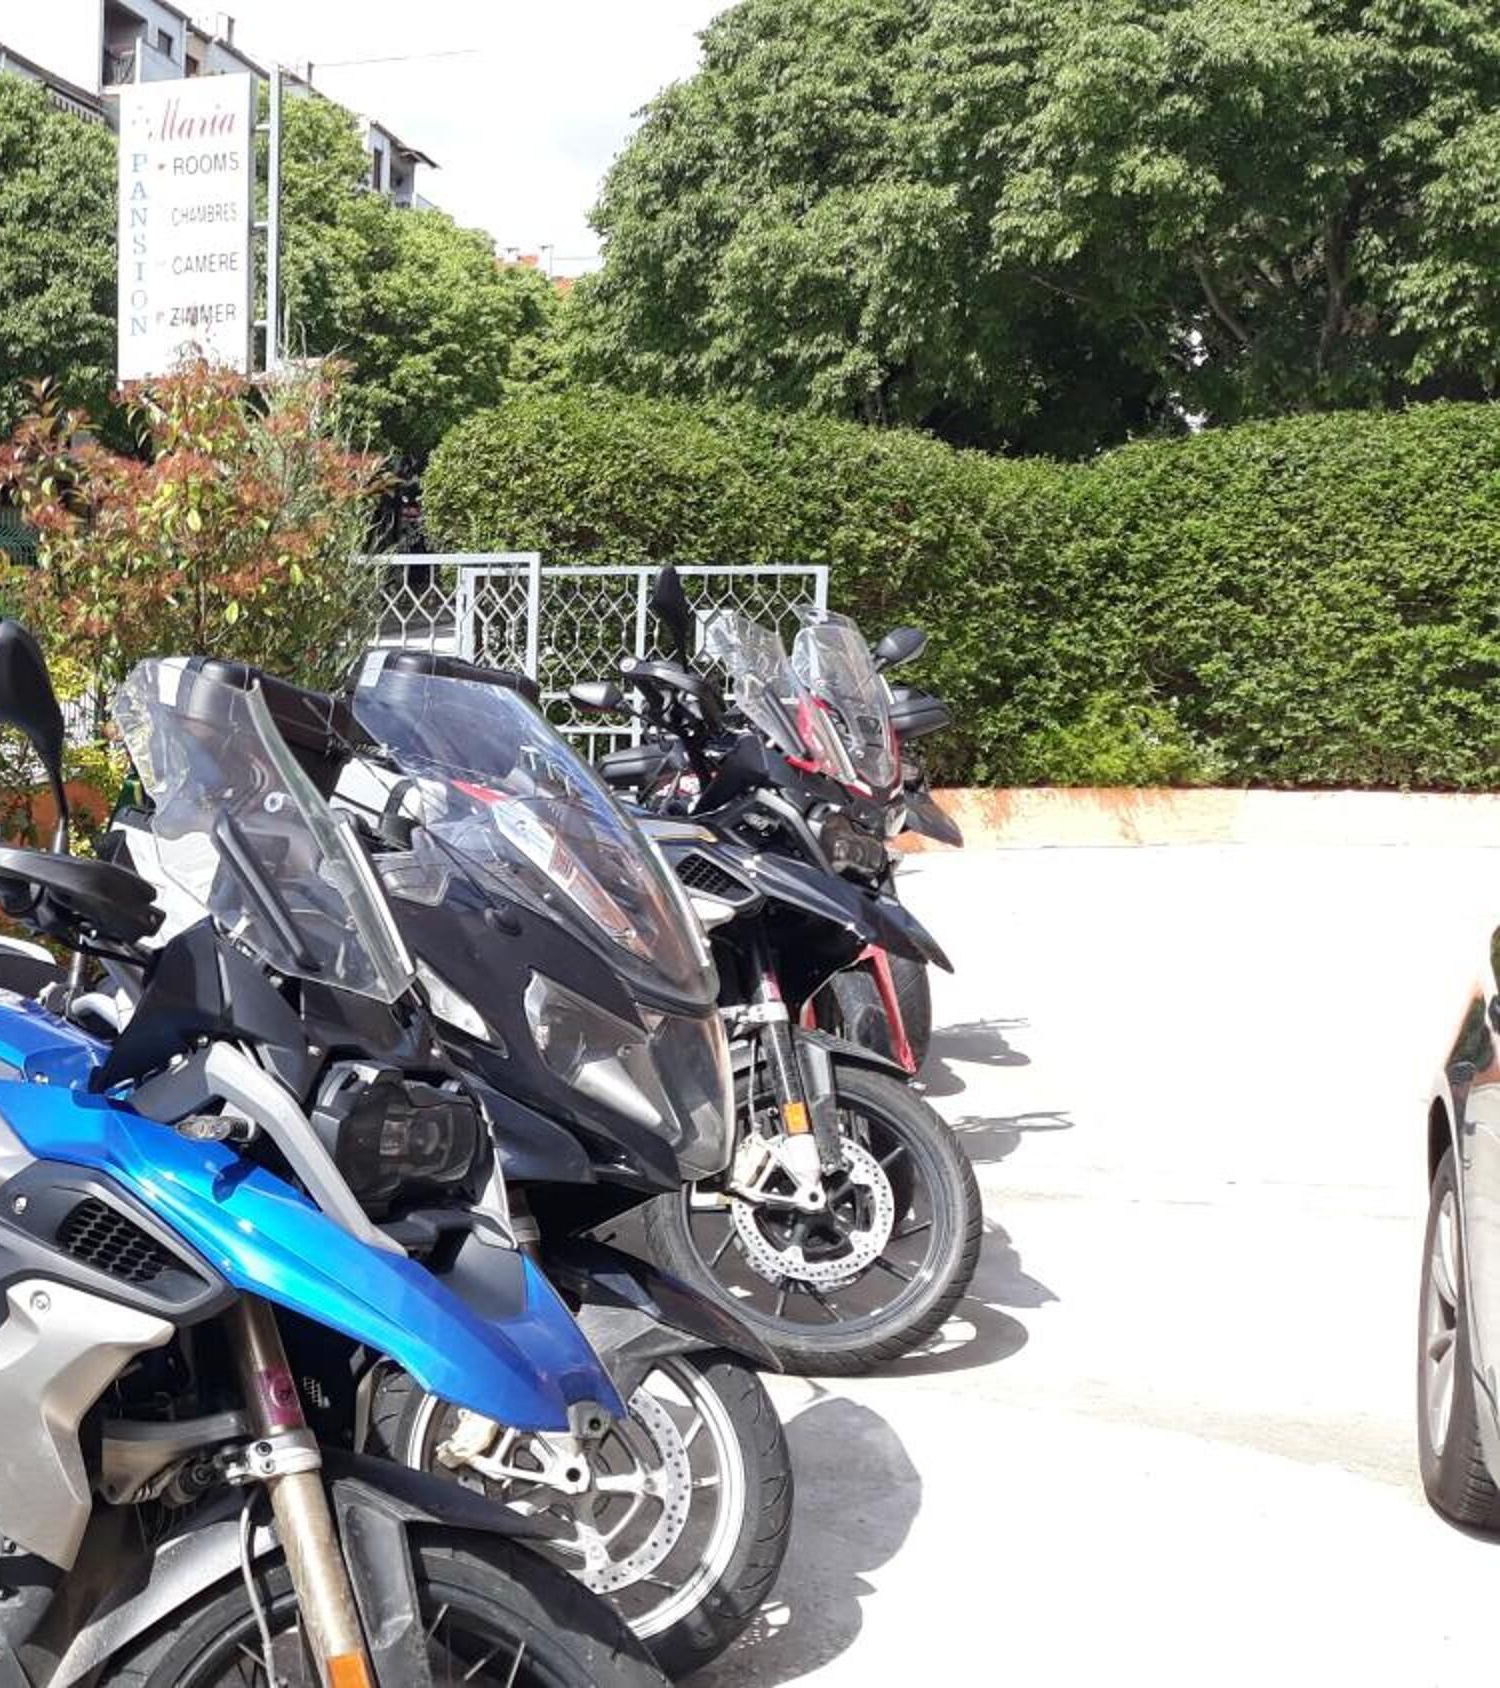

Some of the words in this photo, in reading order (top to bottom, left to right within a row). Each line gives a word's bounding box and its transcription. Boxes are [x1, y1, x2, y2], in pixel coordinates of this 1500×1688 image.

[148, 98, 236, 142] Maria
[173, 152, 239, 176] ROOMS
[171, 202, 237, 226] CHAMBRES
[130, 153, 149, 337] PANSION
[171, 252, 239, 275] CAMERE
[170, 304, 236, 327] ZIMMER
